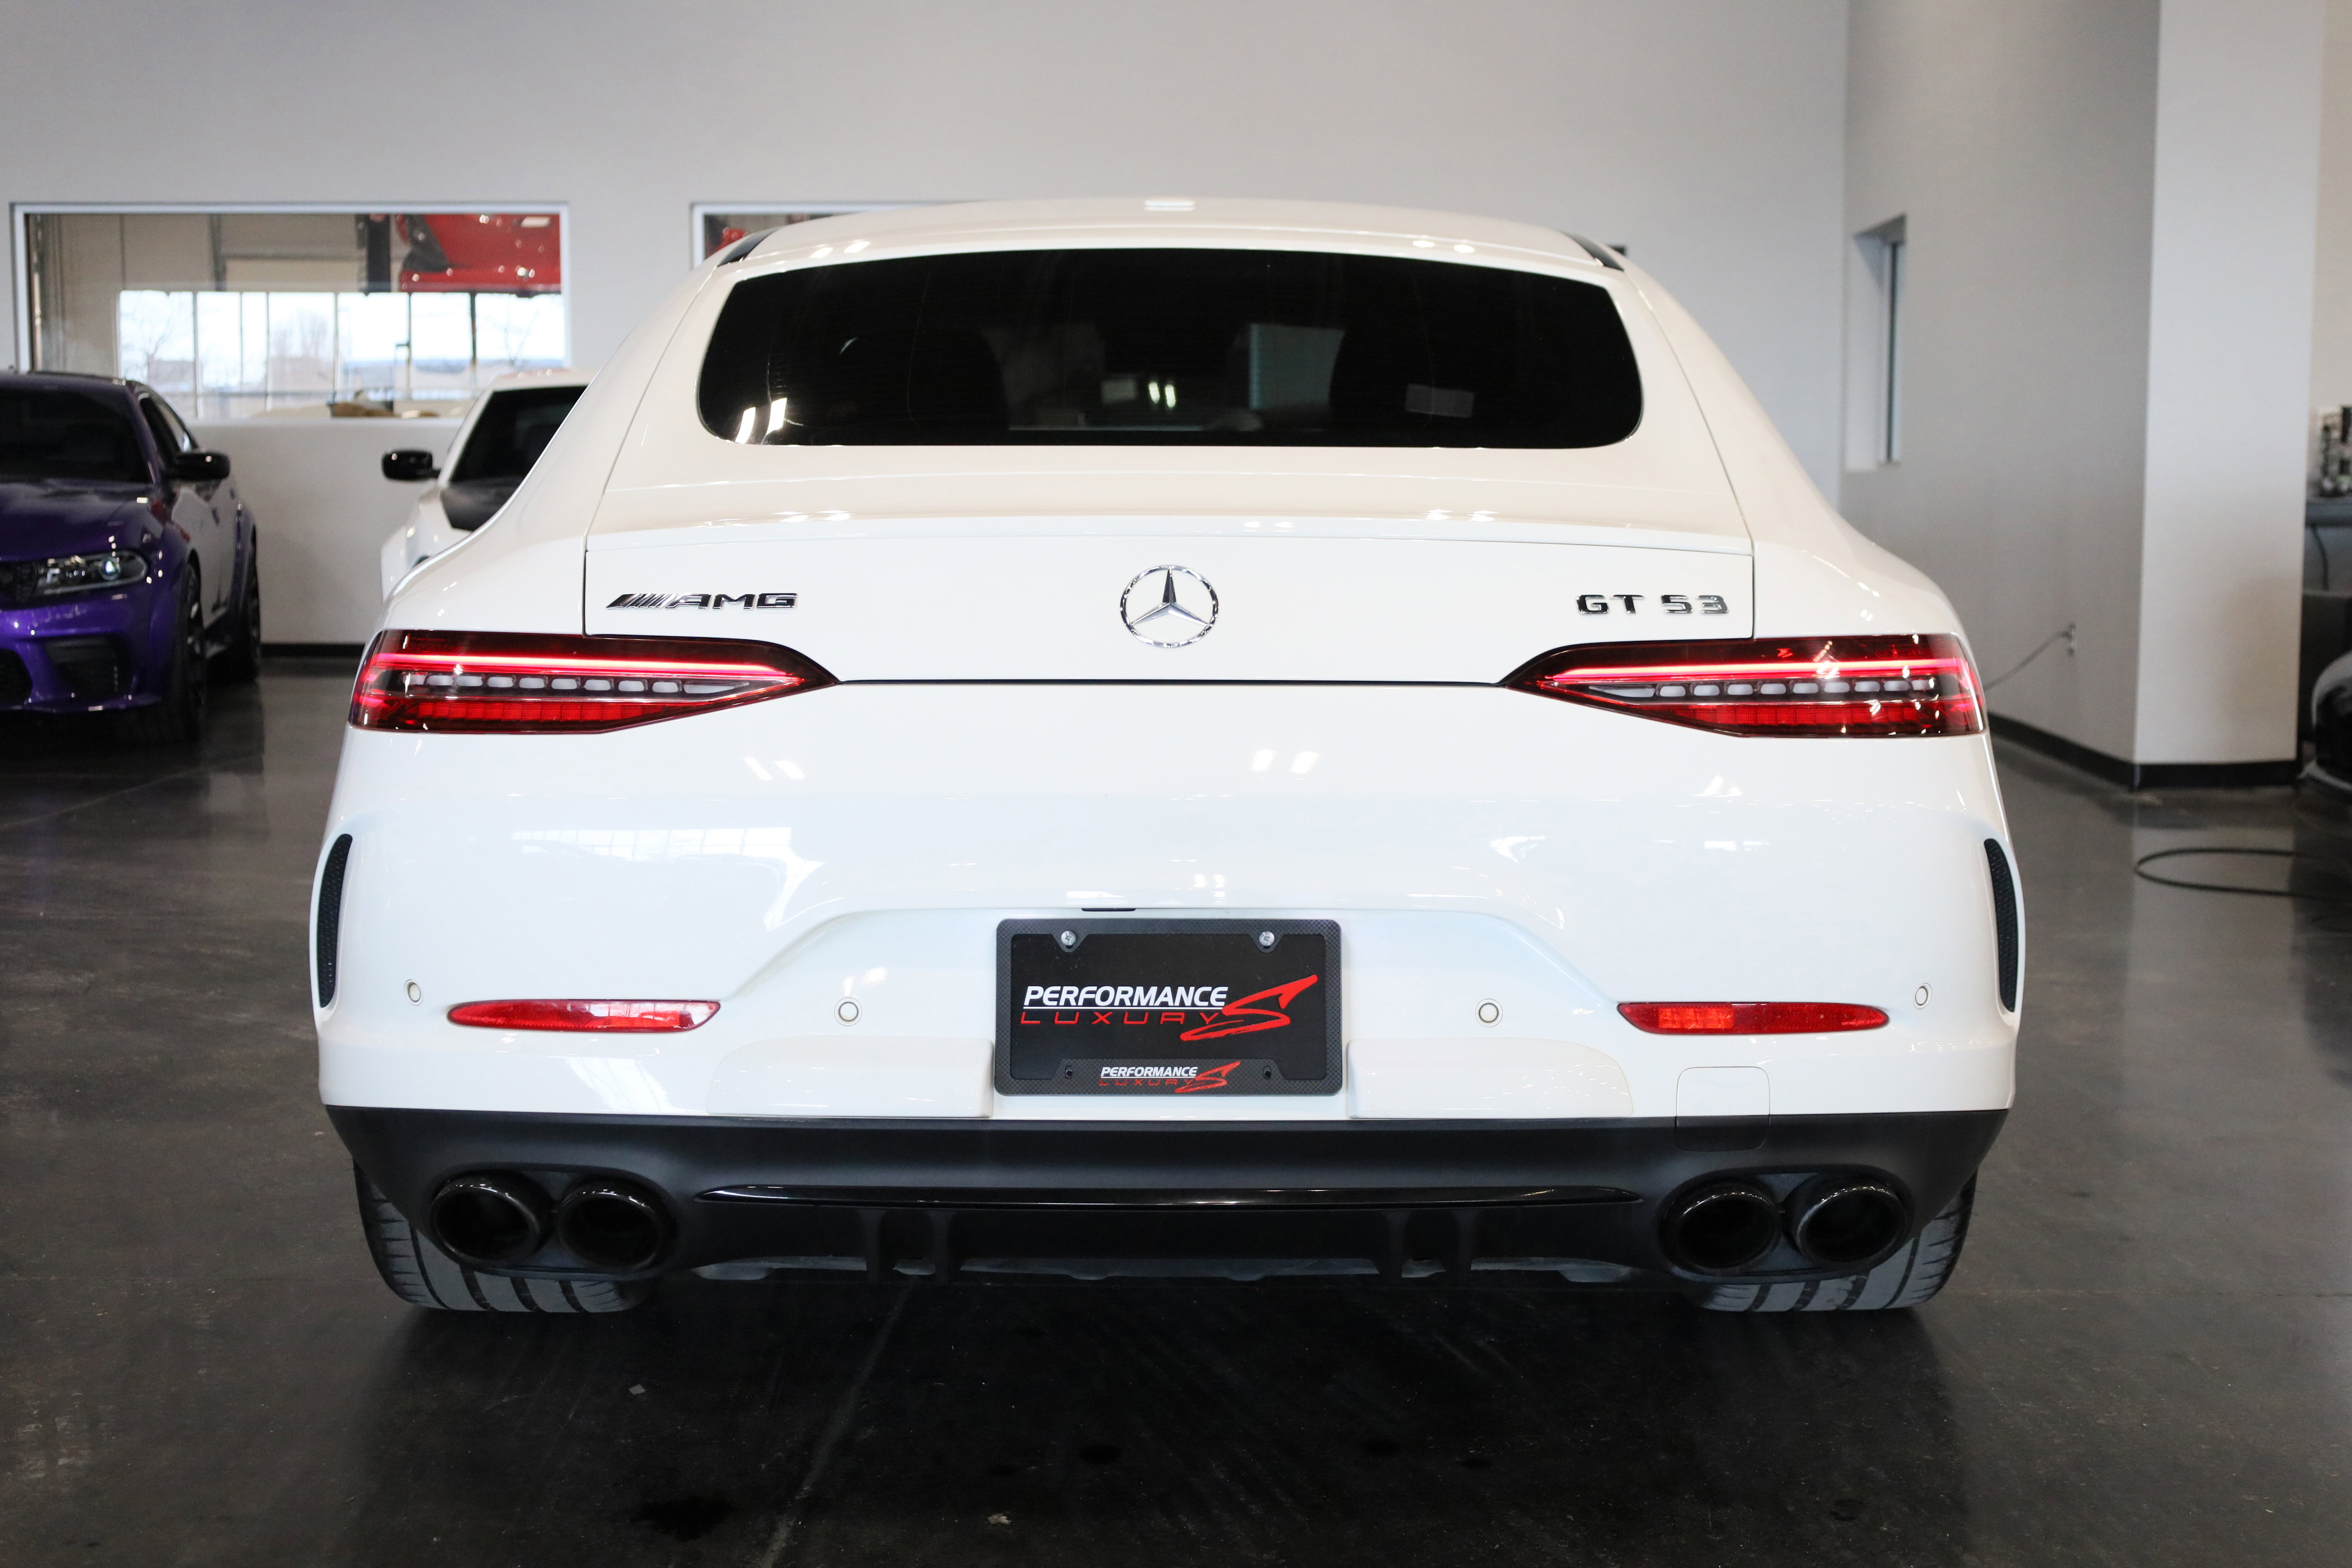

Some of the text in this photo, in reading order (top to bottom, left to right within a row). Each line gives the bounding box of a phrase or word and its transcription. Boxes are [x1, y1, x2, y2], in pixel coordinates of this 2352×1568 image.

[665, 593, 797, 609] AMG
[1575, 595, 1728, 614] GT 53
[1024, 986, 1228, 1007] PERFORMANCE
[1020, 1012, 1219, 1025] LUXURY
[1101, 1066, 1198, 1077] PERFORMANCE
